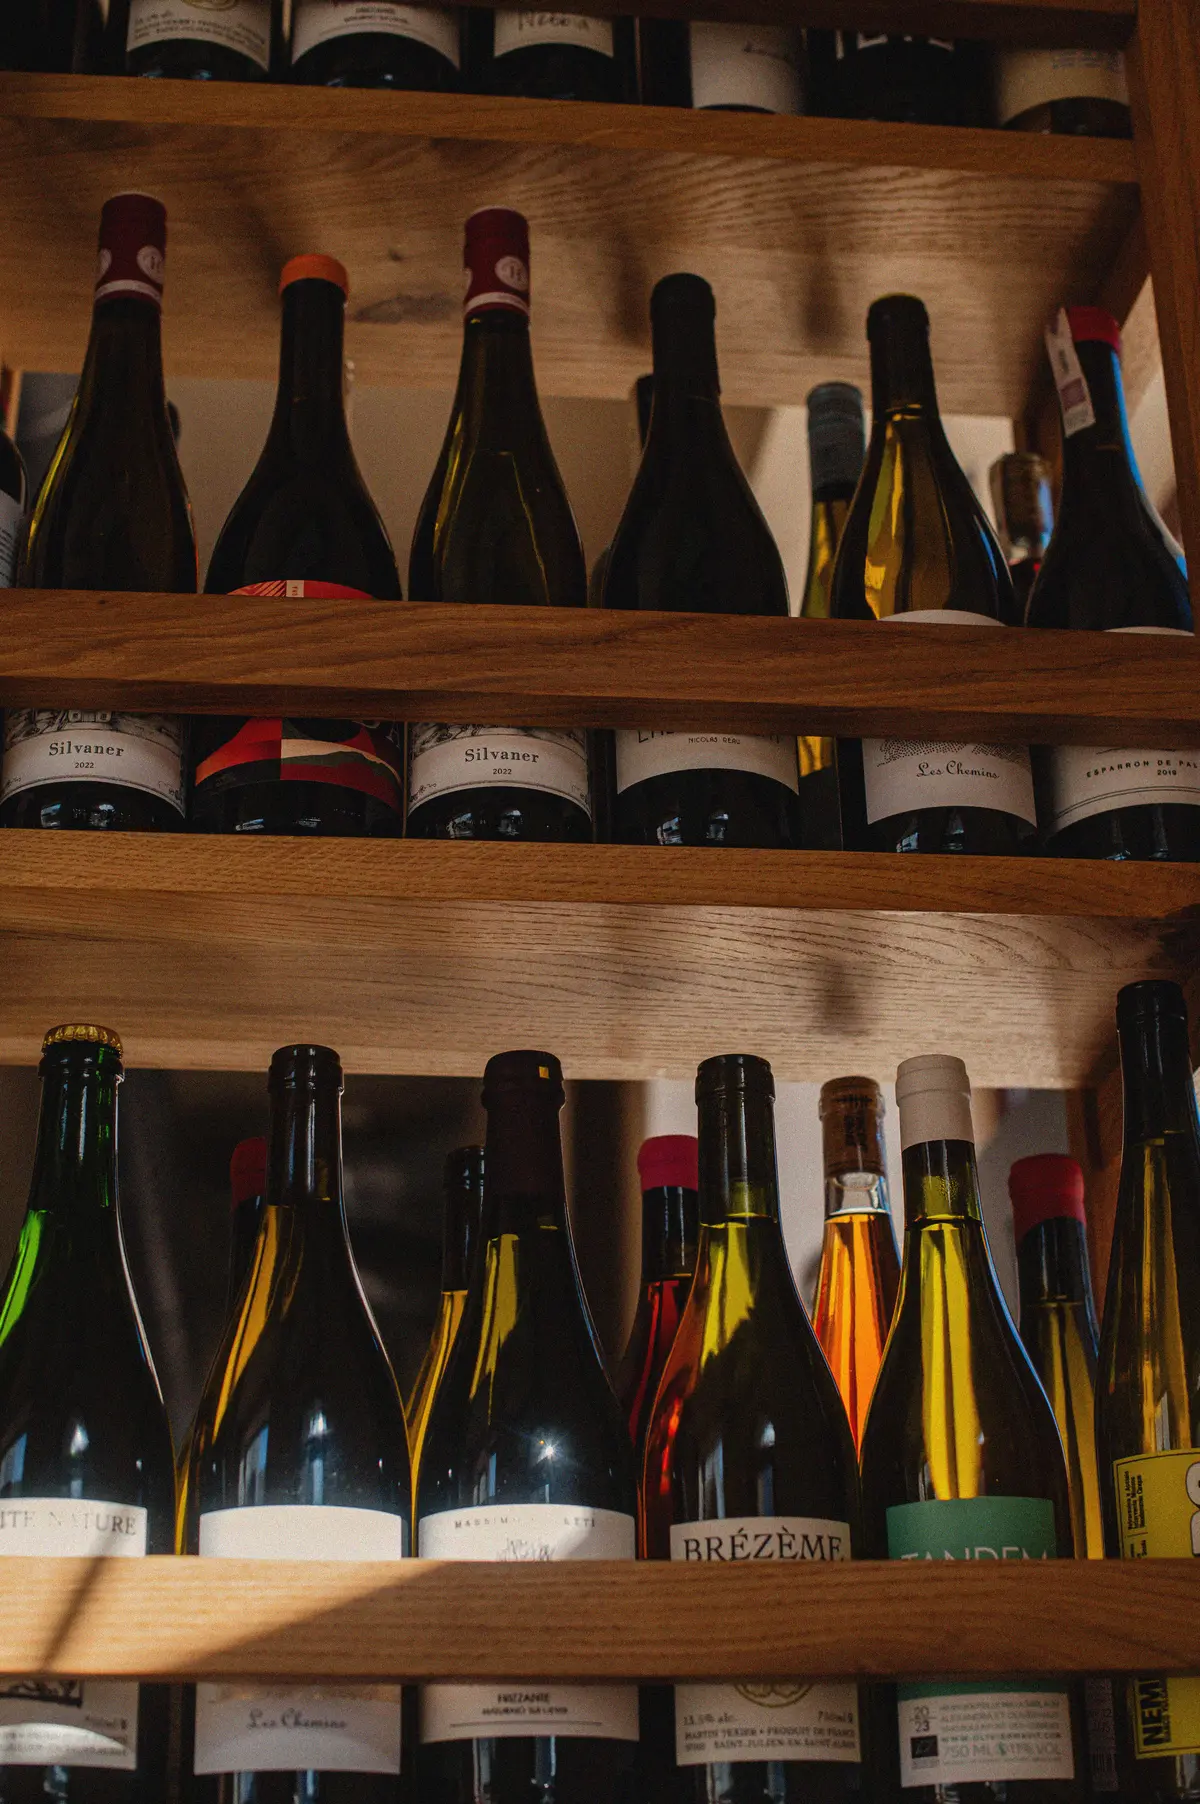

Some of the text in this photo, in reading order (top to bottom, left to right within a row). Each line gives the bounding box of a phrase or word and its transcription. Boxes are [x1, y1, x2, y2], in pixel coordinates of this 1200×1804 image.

[48, 741, 125, 758] Silvaner
[687, 736, 719, 744] NICOLAS
[464, 747, 540, 764] Silvaner
[492, 767, 513, 776] 2022
[916, 759, 1001, 780] Les Chemins
[1085, 759, 1150, 778] ESPARRON
[1157, 759, 1171, 767] DE
[48, 1511, 137, 1536] NATURE
[683, 1525, 845, 1561] BRÉZÈME
[1138, 1678, 1164, 1746] NEM
